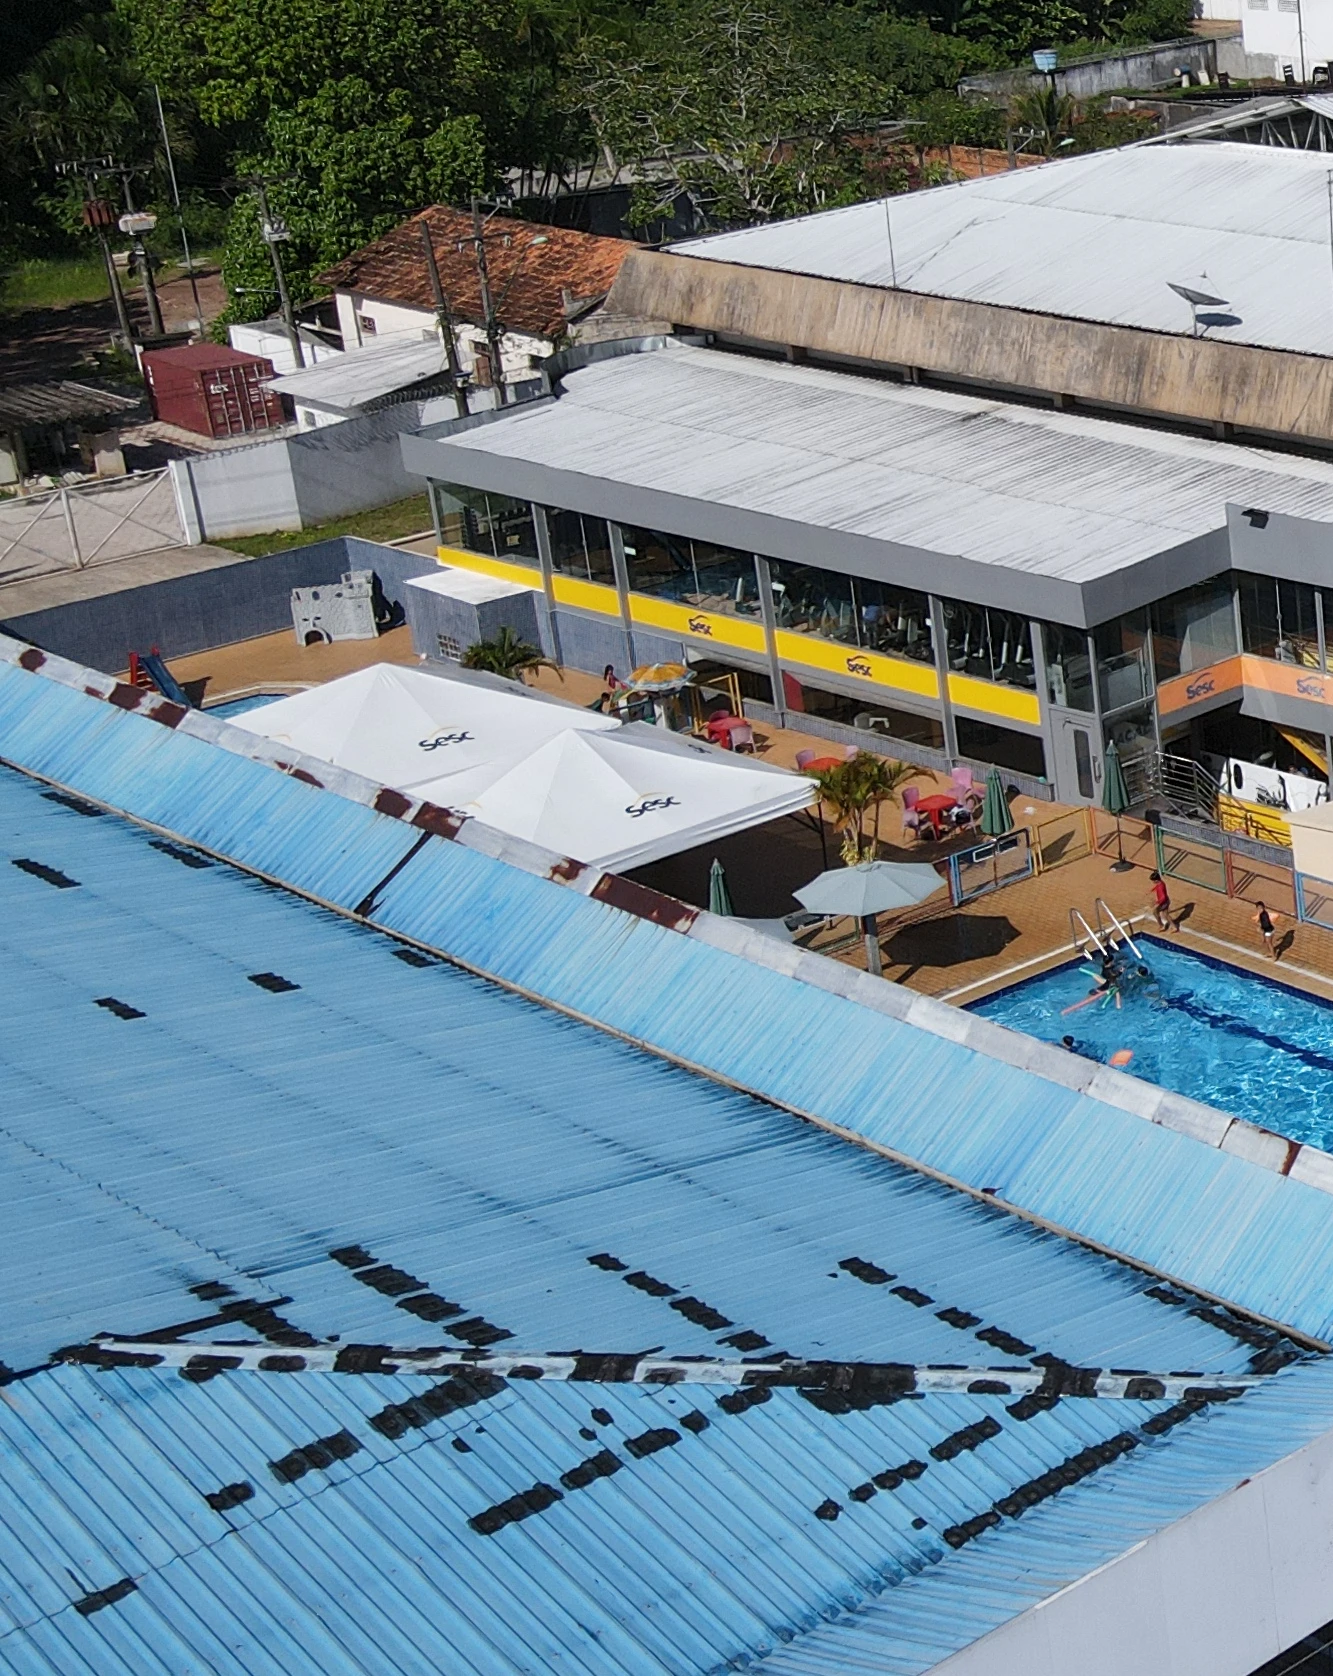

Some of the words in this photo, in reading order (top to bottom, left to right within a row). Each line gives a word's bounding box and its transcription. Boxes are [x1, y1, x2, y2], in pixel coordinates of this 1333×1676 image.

[688, 618, 713, 637] Sesc
[847, 658, 873, 678] Sesc
[1186, 679, 1216, 699] Sesc
[418, 731, 475, 751] Sesc
[625, 796, 681, 818] Sesc
